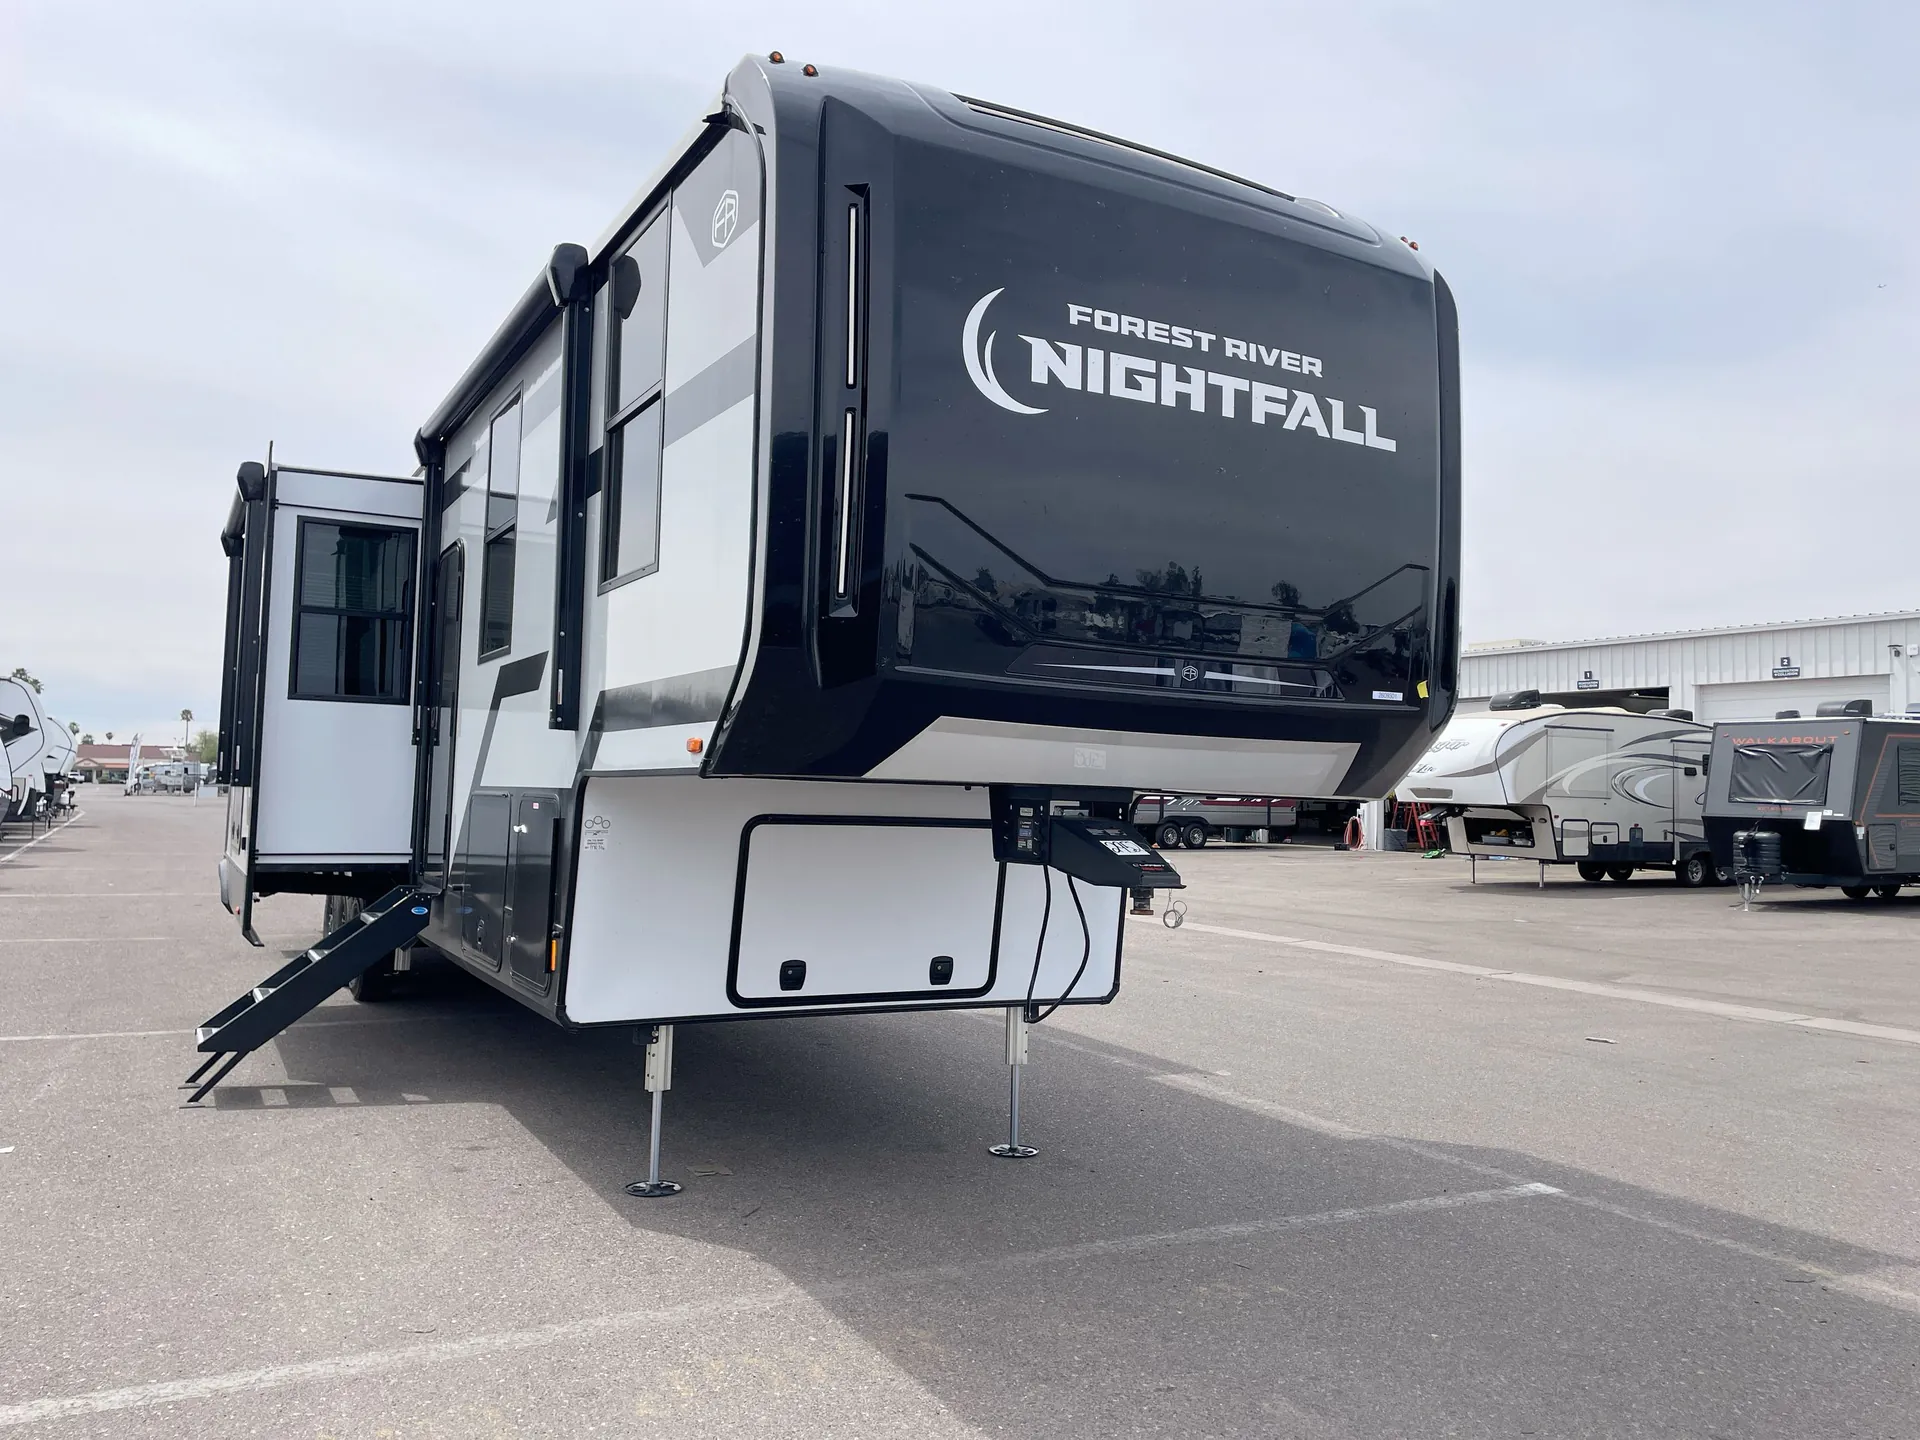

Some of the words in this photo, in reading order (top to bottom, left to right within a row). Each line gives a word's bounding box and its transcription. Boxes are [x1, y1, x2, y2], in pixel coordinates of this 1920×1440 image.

[1066, 303, 1216, 352] FOREST
[1223, 336, 1323, 378] RIVER
[1017, 334, 1397, 452] NIGHTFALL
[1732, 736, 1839, 744] WALKABOUT
